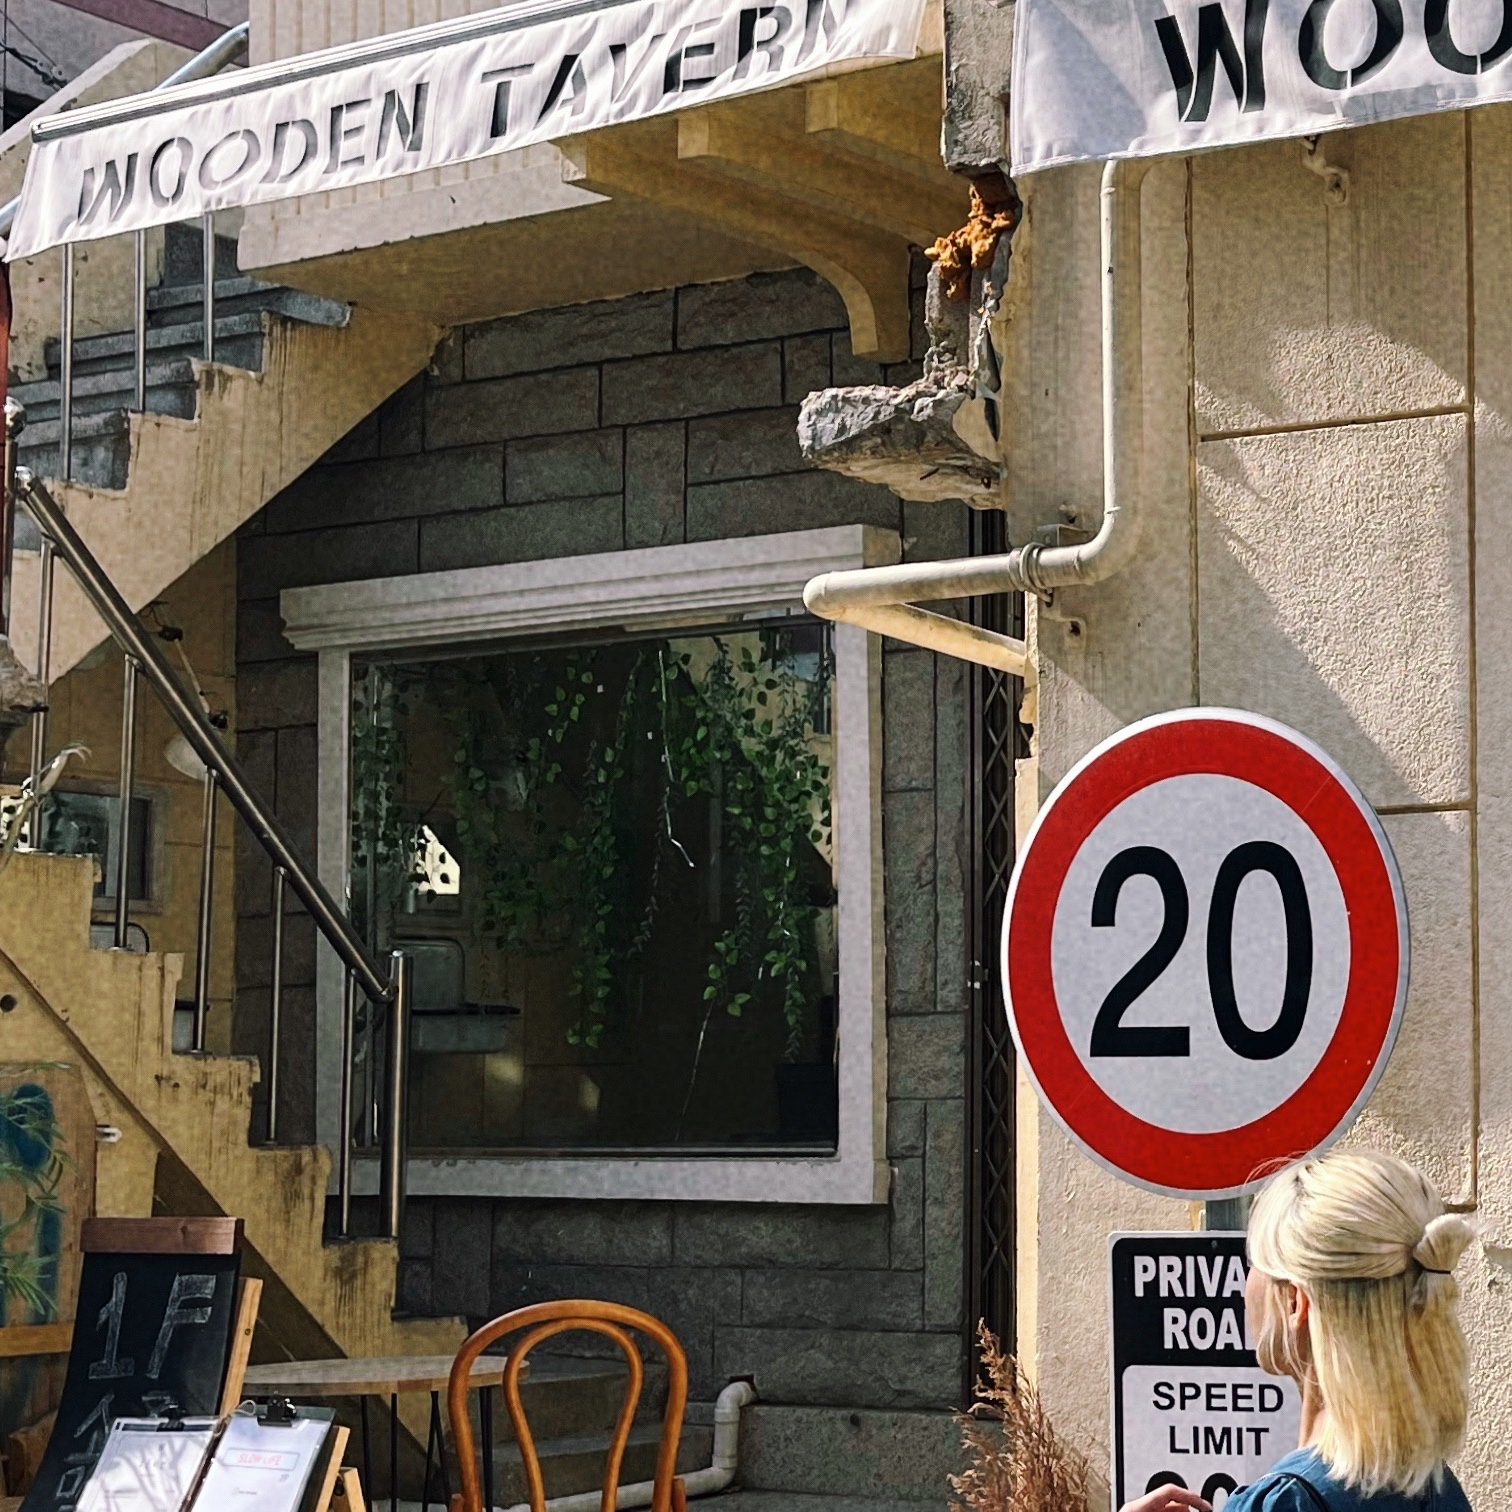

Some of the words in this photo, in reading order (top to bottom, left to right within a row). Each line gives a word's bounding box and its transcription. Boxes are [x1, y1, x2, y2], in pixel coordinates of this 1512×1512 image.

[77, 83, 430, 225] WOODEN
[480, 0, 850, 139] TAVERN
[1090, 840, 1313, 1061] 20
[1133, 1255, 1248, 1299] PRIVA
[87, 1271, 217, 1380] 1F
[1152, 1381, 1284, 1414] SPEED
[1169, 1425, 1270, 1457] LIMIT
